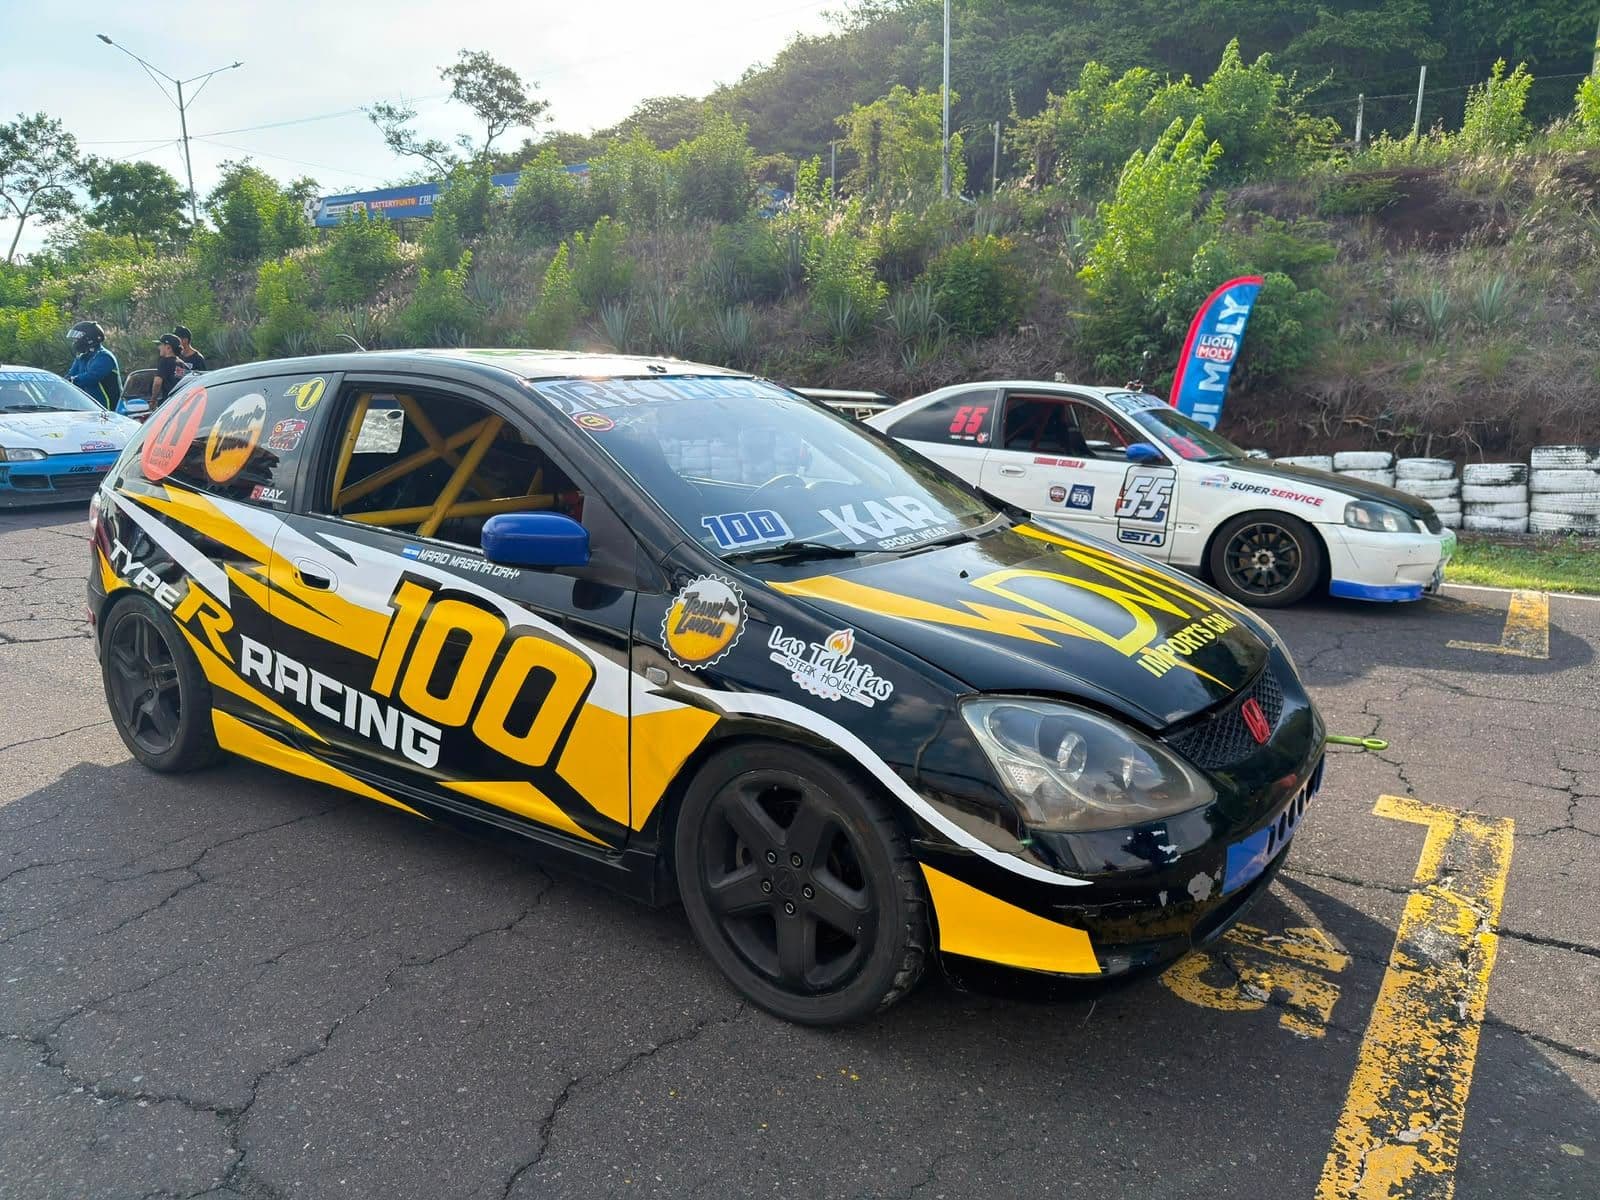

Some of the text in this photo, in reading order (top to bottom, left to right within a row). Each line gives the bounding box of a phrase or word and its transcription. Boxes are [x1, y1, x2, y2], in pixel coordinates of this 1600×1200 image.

[1198, 346, 1233, 361] MOLY
[1201, 335, 1235, 348] LIQUI
[950, 406, 988, 433] 55
[261, 488, 284, 499] RAY
[1072, 493, 1090, 505] FIA
[1115, 476, 1175, 520] 55
[702, 510, 793, 548] 100
[818, 496, 948, 545] KAR
[878, 526, 950, 549] SPORT WEAR
[418, 549, 450, 564] MARIO
[111, 538, 236, 665] TYPE R
[770, 626, 893, 698] Las Tablitas
[1136, 612, 1238, 679] IMPORTS CAR
[370, 579, 594, 767] 100
[786, 657, 859, 698] STEAK HOUSE
[239, 633, 443, 770] RACING
